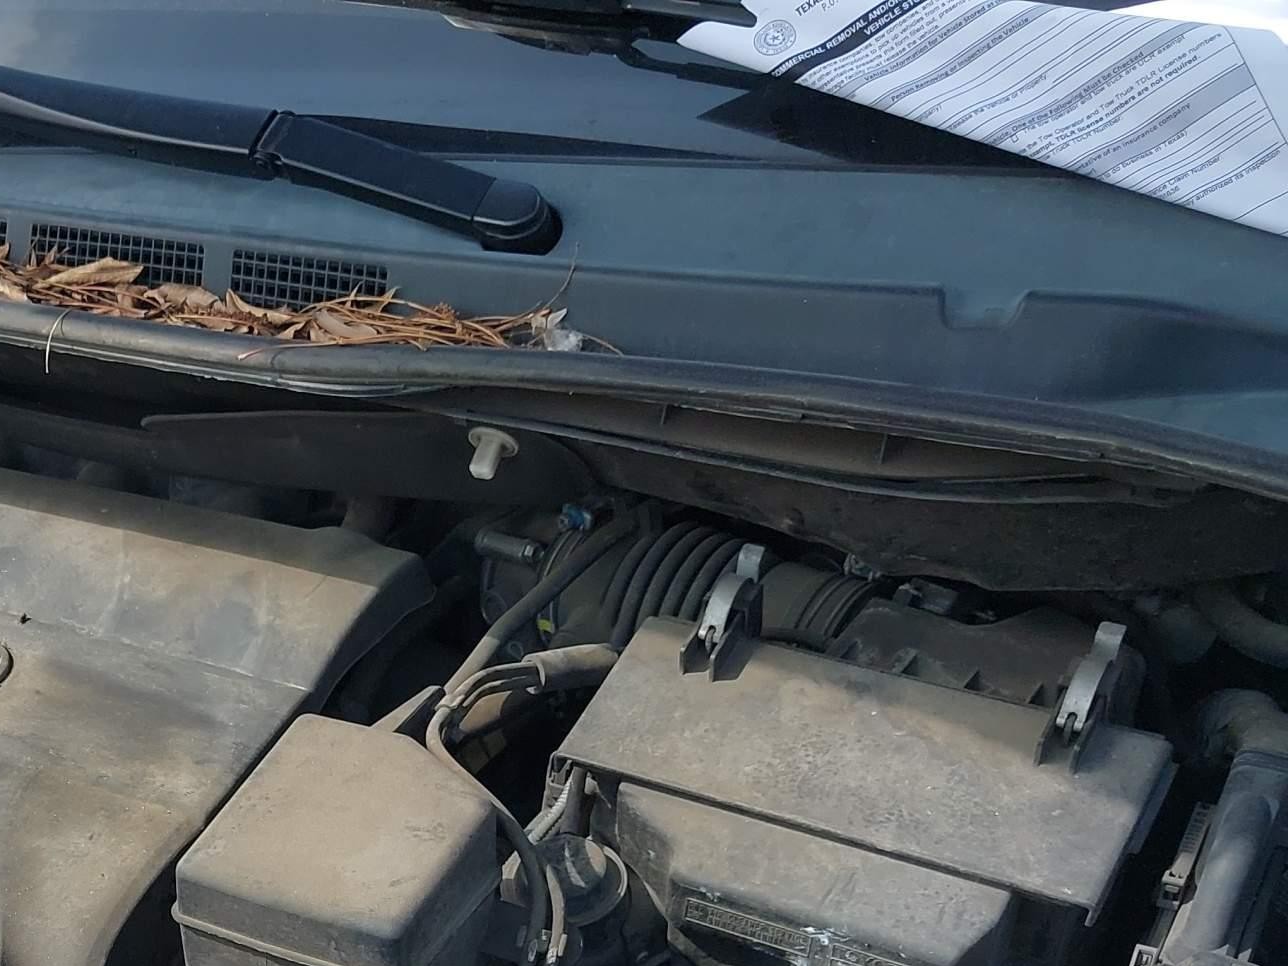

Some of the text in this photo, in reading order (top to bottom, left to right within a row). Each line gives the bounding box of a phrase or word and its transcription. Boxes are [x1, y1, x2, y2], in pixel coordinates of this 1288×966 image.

[824, 17, 867, 49] REMOVAL
[863, 7, 902, 36] VEHICLE
[877, 39, 890, 50] pick
[898, 15, 924, 34] vehicles
[894, 34, 910, 46] form
[924, 36, 939, 48] for
[937, 20, 964, 40] Vehicle
[962, 4, 986, 22] Stored
[990, 33, 1003, 44] the
[1002, 15, 1029, 35] Vehicle
[906, 39, 917, 48] the
[1038, 131, 1052, 143] Tow
[1053, 115, 1085, 136] Operator
[1085, 108, 1099, 119] and
[1099, 98, 1115, 110] Tow
[1114, 85, 1135, 100] Truck
[1134, 69, 1157, 86] TDLR
[1156, 50, 1188, 73] License
[1186, 30, 1222, 54] numbers
[1079, 93, 1093, 104] and
[1124, 65, 1137, 75] are
[1156, 34, 1187, 55] exempt
[1082, 79, 1102, 93] Must
[1110, 51, 1145, 74] Checked
[1056, 128, 1075, 143] TDLR
[1076, 114, 1104, 133] license
[1103, 93, 1136, 118] numbers
[1135, 85, 1149, 96] are
[1148, 75, 1164, 87] not
[1162, 52, 1202, 80] required.
[1120, 123, 1159, 148] insurance
[1156, 102, 1193, 128] company
[1194, 176, 1234, 201] authorized
[1244, 148, 1281, 175] inspection
